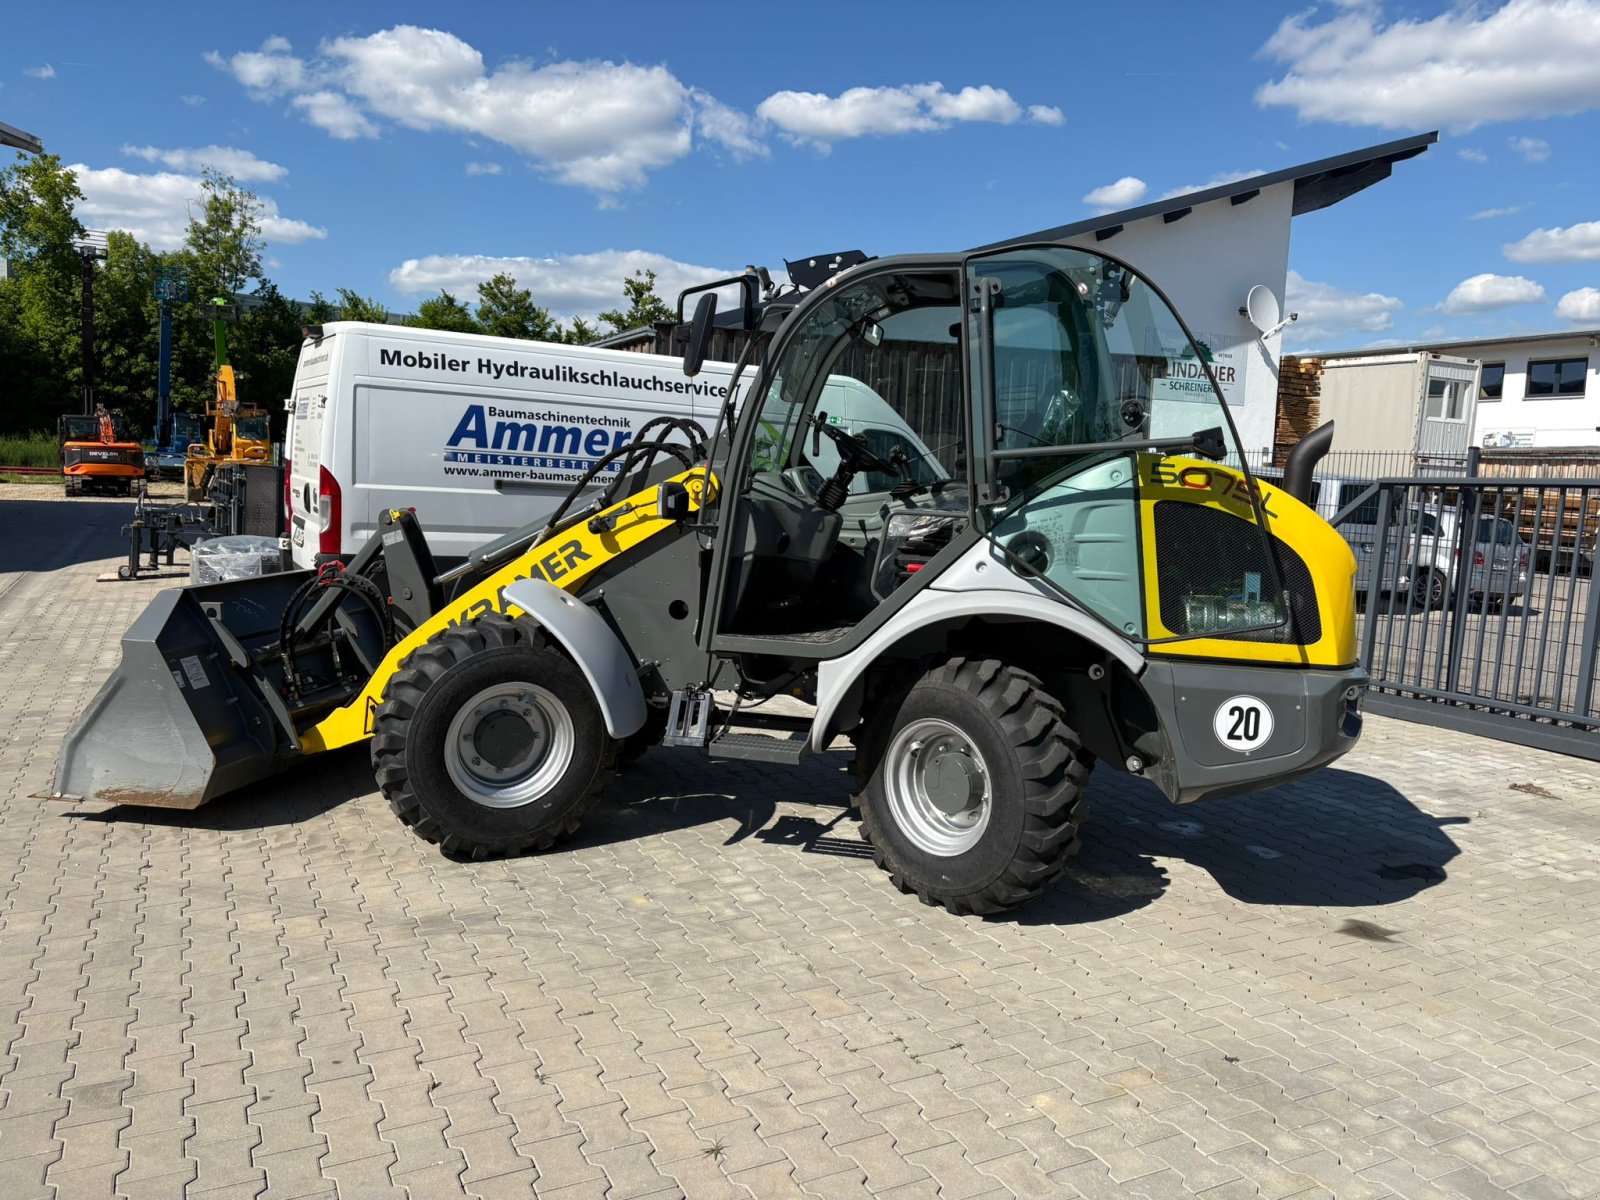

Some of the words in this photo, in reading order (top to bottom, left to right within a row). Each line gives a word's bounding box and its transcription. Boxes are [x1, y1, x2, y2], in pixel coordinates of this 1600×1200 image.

[380, 348, 470, 372] Mobiler
[478, 358, 728, 398] Hydraulikschlauchservice
[1166, 361, 1235, 383] INDAUER
[1169, 381, 1218, 394] SCHREINER
[488, 406, 631, 428] Baumaschinentechnik
[446, 404, 632, 458] Ammer
[457, 453, 621, 472] MEISTERBETRB
[443, 465, 615, 484] www.ammer-baumascnen
[1227, 705, 1260, 741] 20
